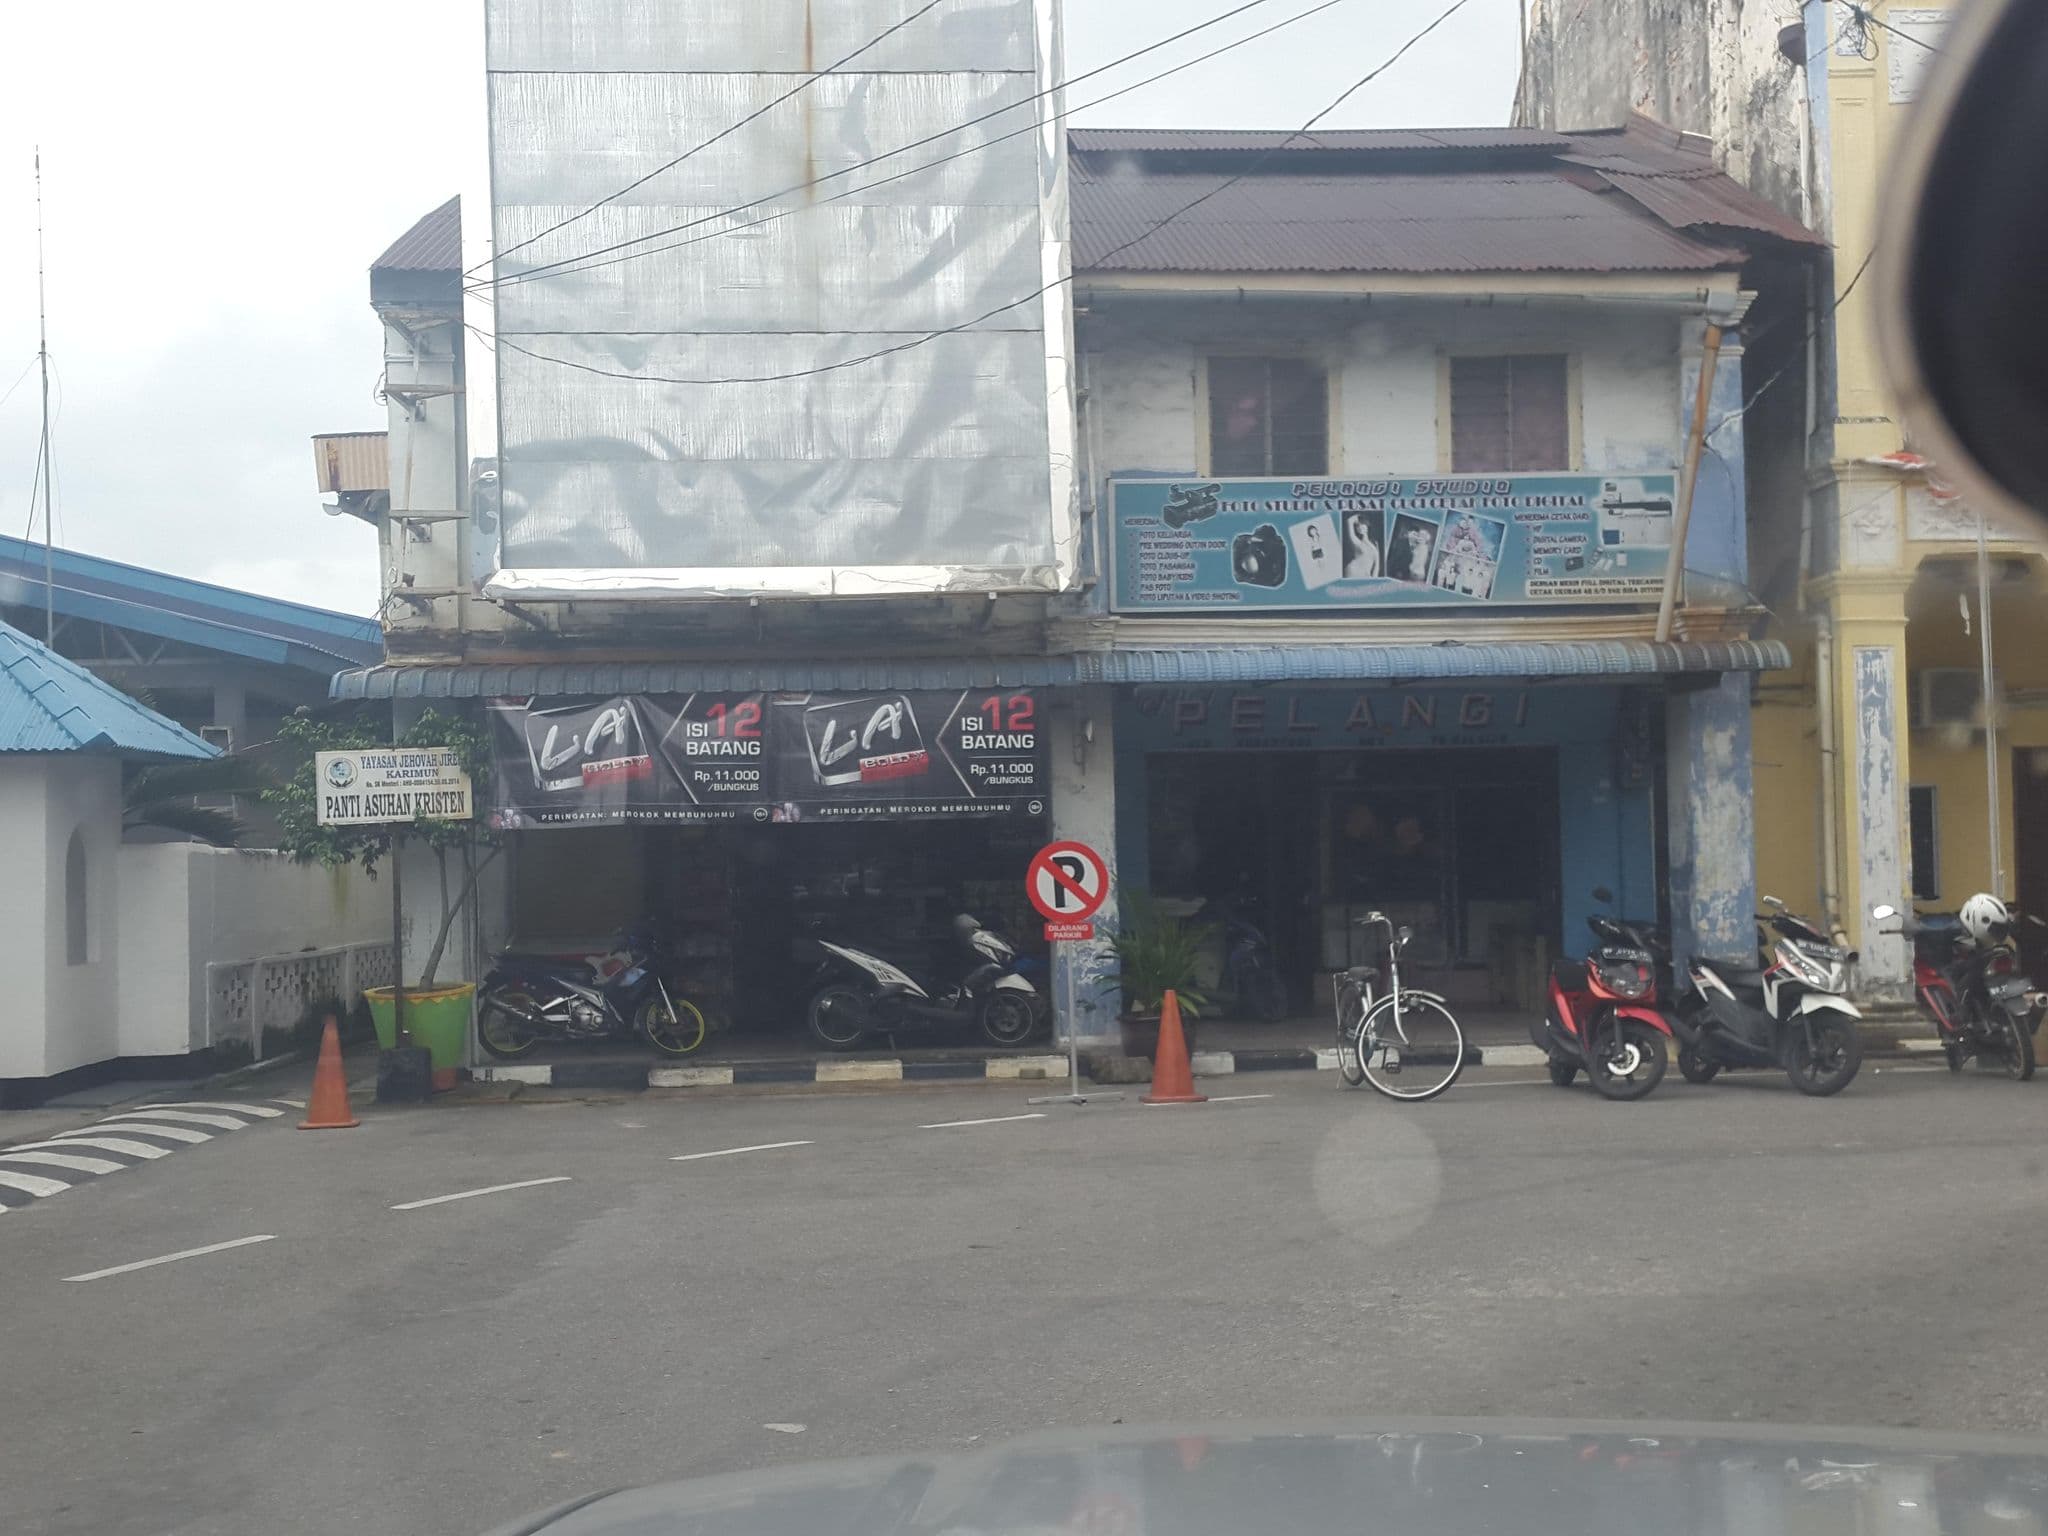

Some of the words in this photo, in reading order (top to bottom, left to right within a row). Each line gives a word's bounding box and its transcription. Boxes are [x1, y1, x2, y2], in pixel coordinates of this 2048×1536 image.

[1291, 480, 1401, 497] PELANGI
[1414, 479, 1513, 495] STUDIO
[1221, 501, 1258, 513] FOTO
[1265, 500, 1317, 512] STUDIO
[1337, 499, 1385, 511] PUSAT
[1390, 498, 1426, 509] CUCI
[1430, 497, 1475, 508] CETAK
[1482, 497, 1519, 508] FOTO
[1525, 495, 1586, 507] DIGITAL
[1139, 531, 1156, 539] FOTO
[1139, 552, 1156, 560] FOTO
[1139, 563, 1157, 571] FOTO
[1155, 584, 1171, 592] FOTO
[1139, 593, 1156, 601] FOTO
[961, 717, 983, 732] ISI
[981, 695, 1035, 731] 12
[1172, 691, 1529, 735] PELANGI
[686, 723, 709, 738] ISI
[706, 702, 762, 738] 12
[961, 735, 1035, 749] BATANG
[686, 741, 761, 756] BATANG
[360, 755, 398, 770] YAYASAN
[399, 754, 438, 769] JEHOVAH
[386, 769, 439, 779] KARIMUN
[970, 763, 1034, 776] Rp.11.000
[694, 770, 760, 784] Rp.11.000
[983, 775, 1034, 785] /BUNGKUS
[707, 782, 760, 792] /BUNGKUS
[326, 795, 361, 819] PANTI
[364, 792, 411, 817] ASUHAN
[415, 791, 465, 814] KRISTEN
[890, 805, 937, 813] MEROKOK
[941, 804, 1012, 812] MEMBUNUHMU
[611, 811, 660, 819] MEROKOK
[664, 810, 736, 819] MEMBUNUHMU
[1047, 924, 1089, 932] DILARANG
